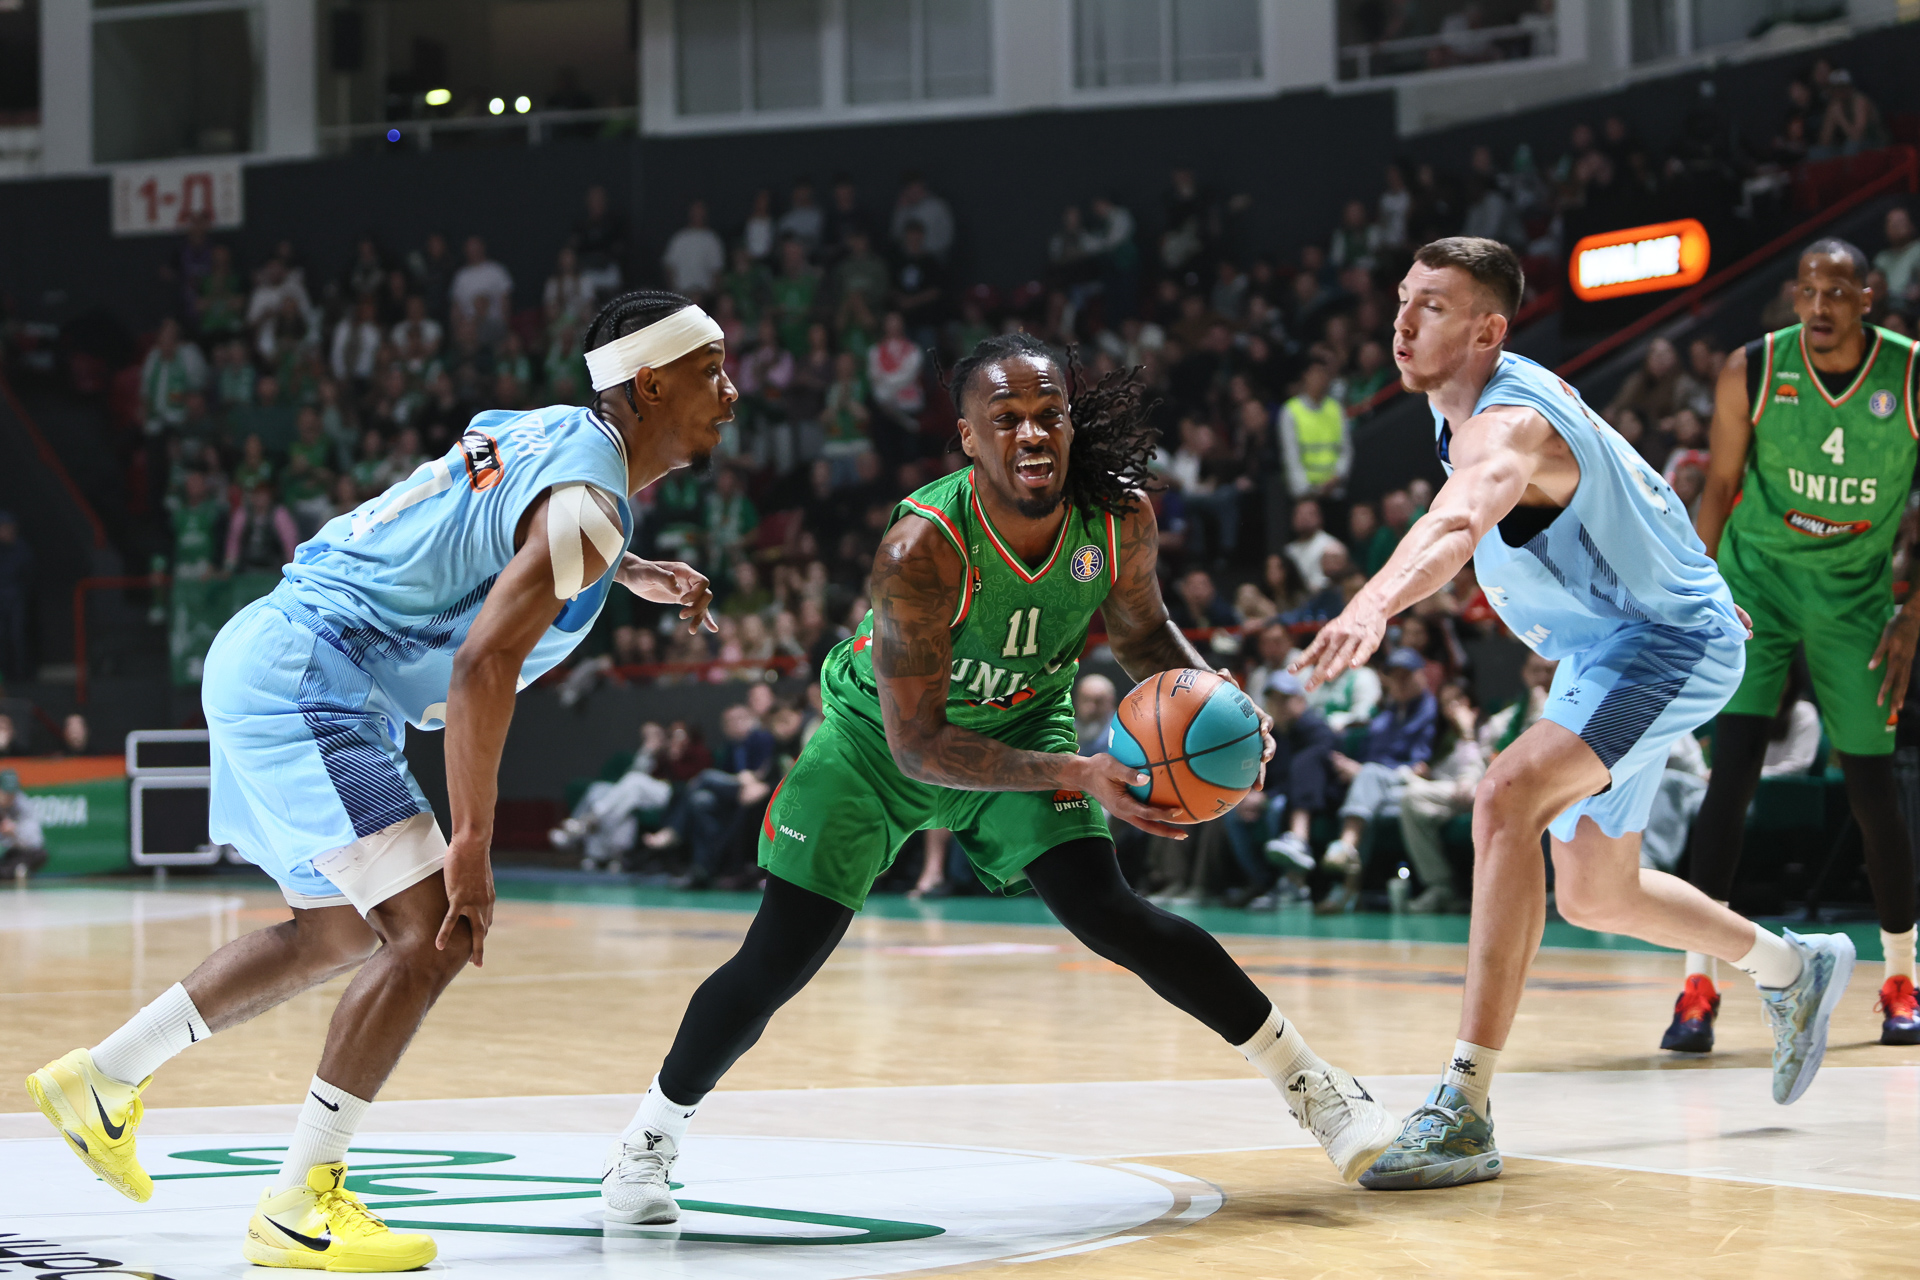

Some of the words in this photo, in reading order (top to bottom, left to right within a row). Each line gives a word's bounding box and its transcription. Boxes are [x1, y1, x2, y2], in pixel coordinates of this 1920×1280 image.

[1821, 427, 1845, 465] 4
[1788, 467, 1878, 504] UNICS
[1002, 606, 1042, 658] 11
[950, 656, 1062, 698] UNI
[1053, 799, 1089, 812] UNICS
[779, 824, 807, 842] MAXX
